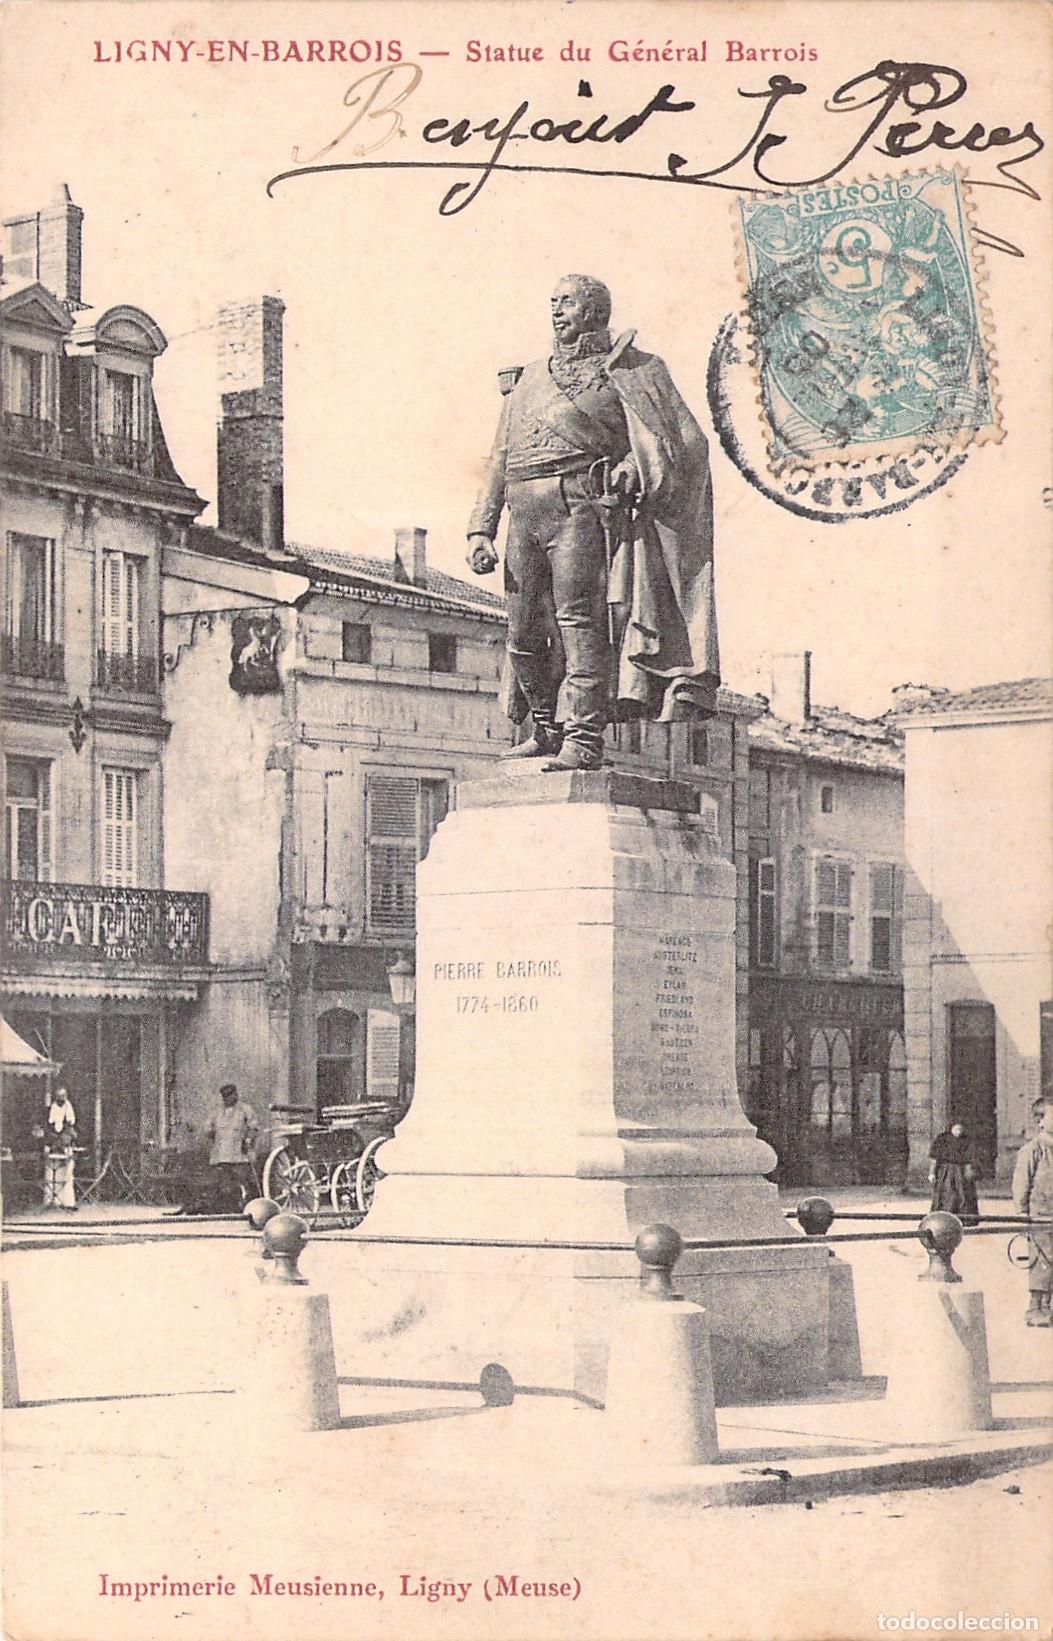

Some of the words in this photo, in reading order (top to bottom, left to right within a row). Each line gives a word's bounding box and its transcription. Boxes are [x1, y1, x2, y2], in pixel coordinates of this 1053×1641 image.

[802, 181, 896, 215] POSTES
[433, 962, 486, 981] PIERRE
[495, 959, 562, 979] BARROIS
[455, 994, 540, 1015] 1774-1860
